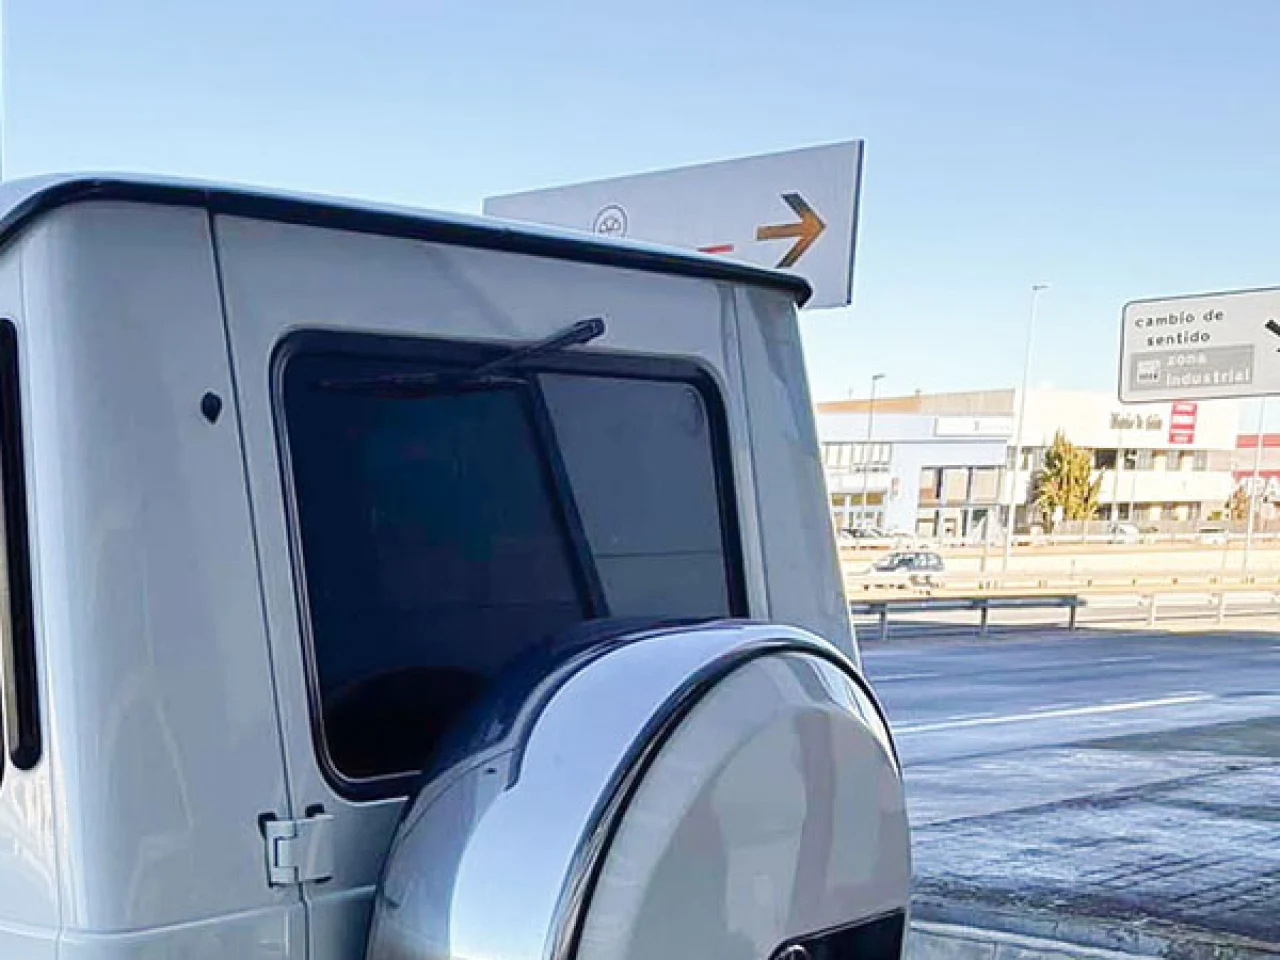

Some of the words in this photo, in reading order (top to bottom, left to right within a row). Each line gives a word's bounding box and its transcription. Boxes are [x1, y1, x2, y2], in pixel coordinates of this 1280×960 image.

[1134, 311, 1196, 328] cambio
[1202, 309, 1225, 323] de
[1147, 330, 1211, 346] sentido
[1167, 352, 1208, 367] zona
[1166, 366, 1250, 387] industrial
